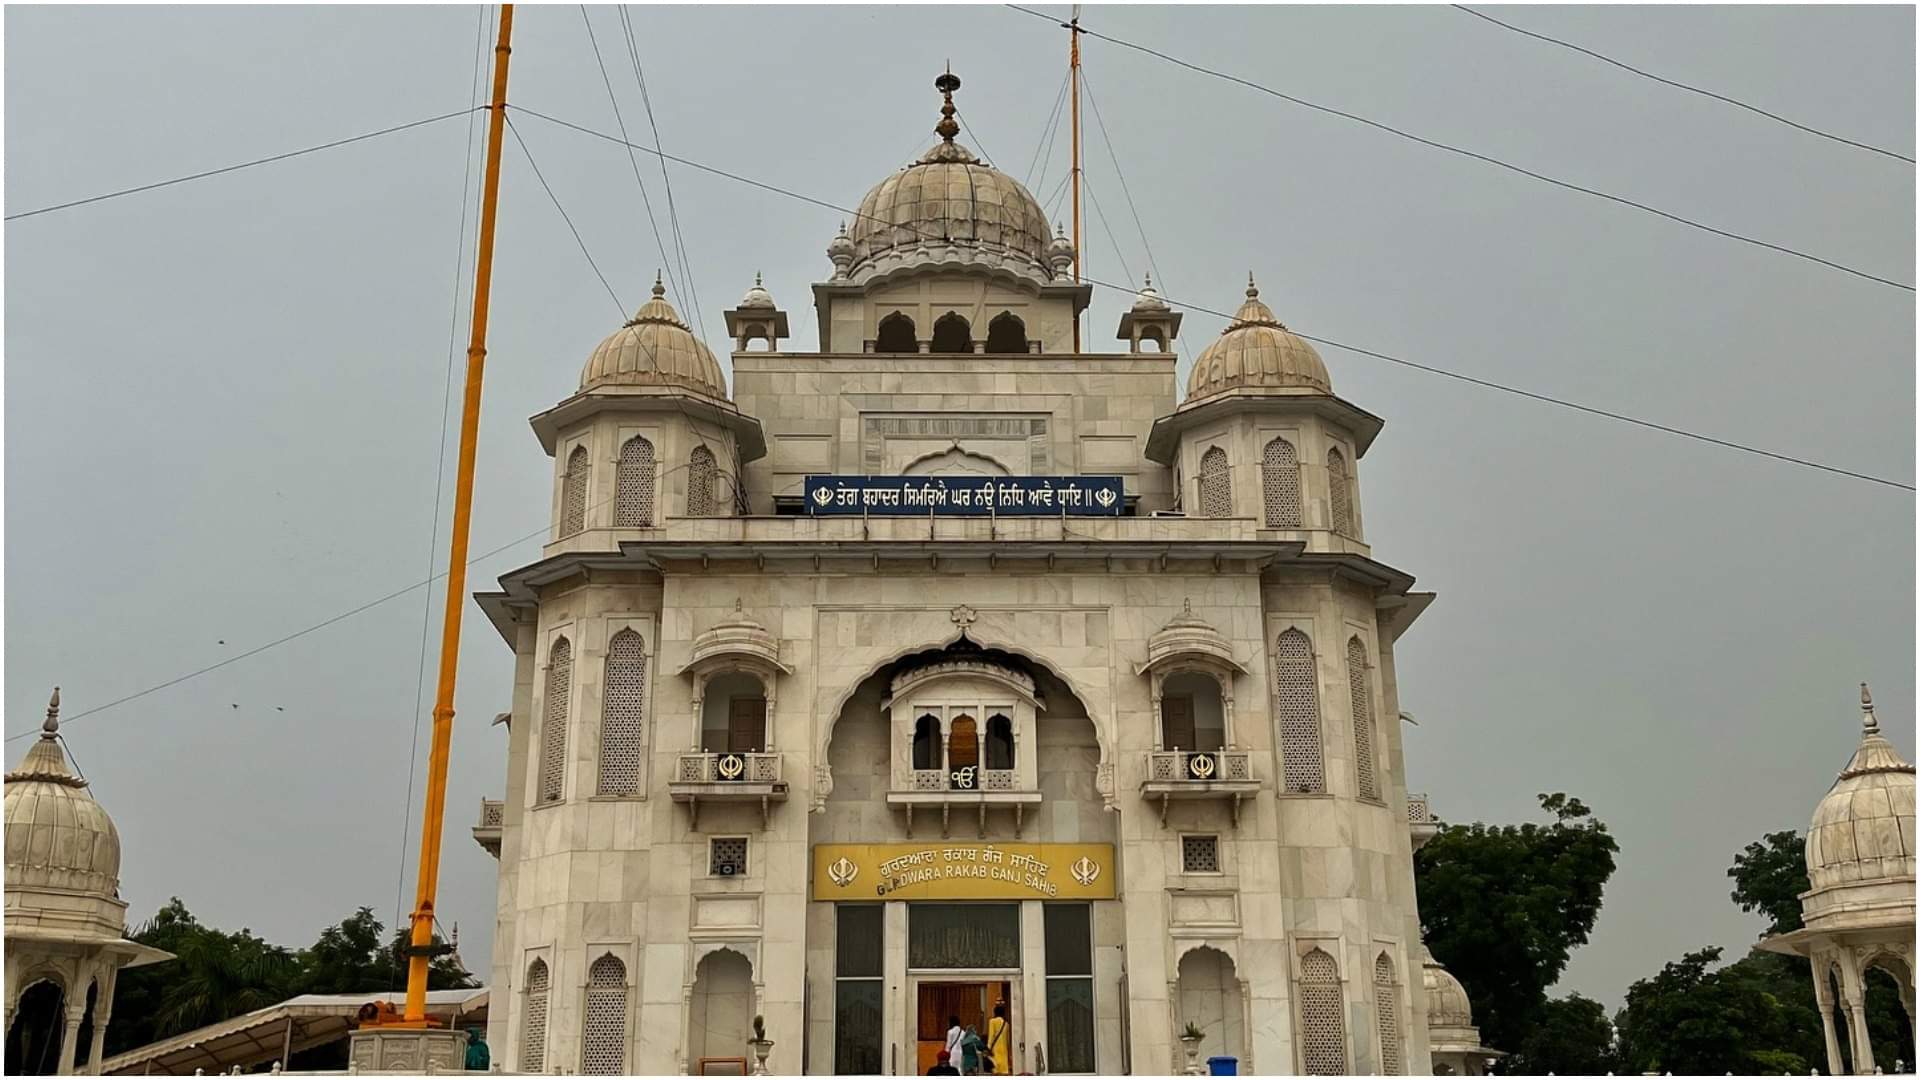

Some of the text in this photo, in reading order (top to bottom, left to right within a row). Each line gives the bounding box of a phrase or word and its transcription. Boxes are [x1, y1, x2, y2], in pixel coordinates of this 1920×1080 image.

[836, 482, 859, 506] ਤੇਗ
[863, 488, 900, 506] ਬਹਾਦਰ
[903, 480, 948, 506] ਸਿਮਰਿਐ
[951, 488, 972, 506] ਘਰ
[999, 483, 1025, 506] ਨਿਧਿ
[1028, 480, 1054, 506] ਆਵੈ
[1057, 483, 1082, 506] ਧਾਇ
[879, 845, 1049, 878] ਗੁਰਦੁਆਰਾ ਰਕਾਬ ਗੰਜ ਸਾਹਿਬ
[945, 865, 987, 878] RAKAB
[991, 866, 1021, 883] GANJ
[1024, 873, 1057, 897] SAHIB
